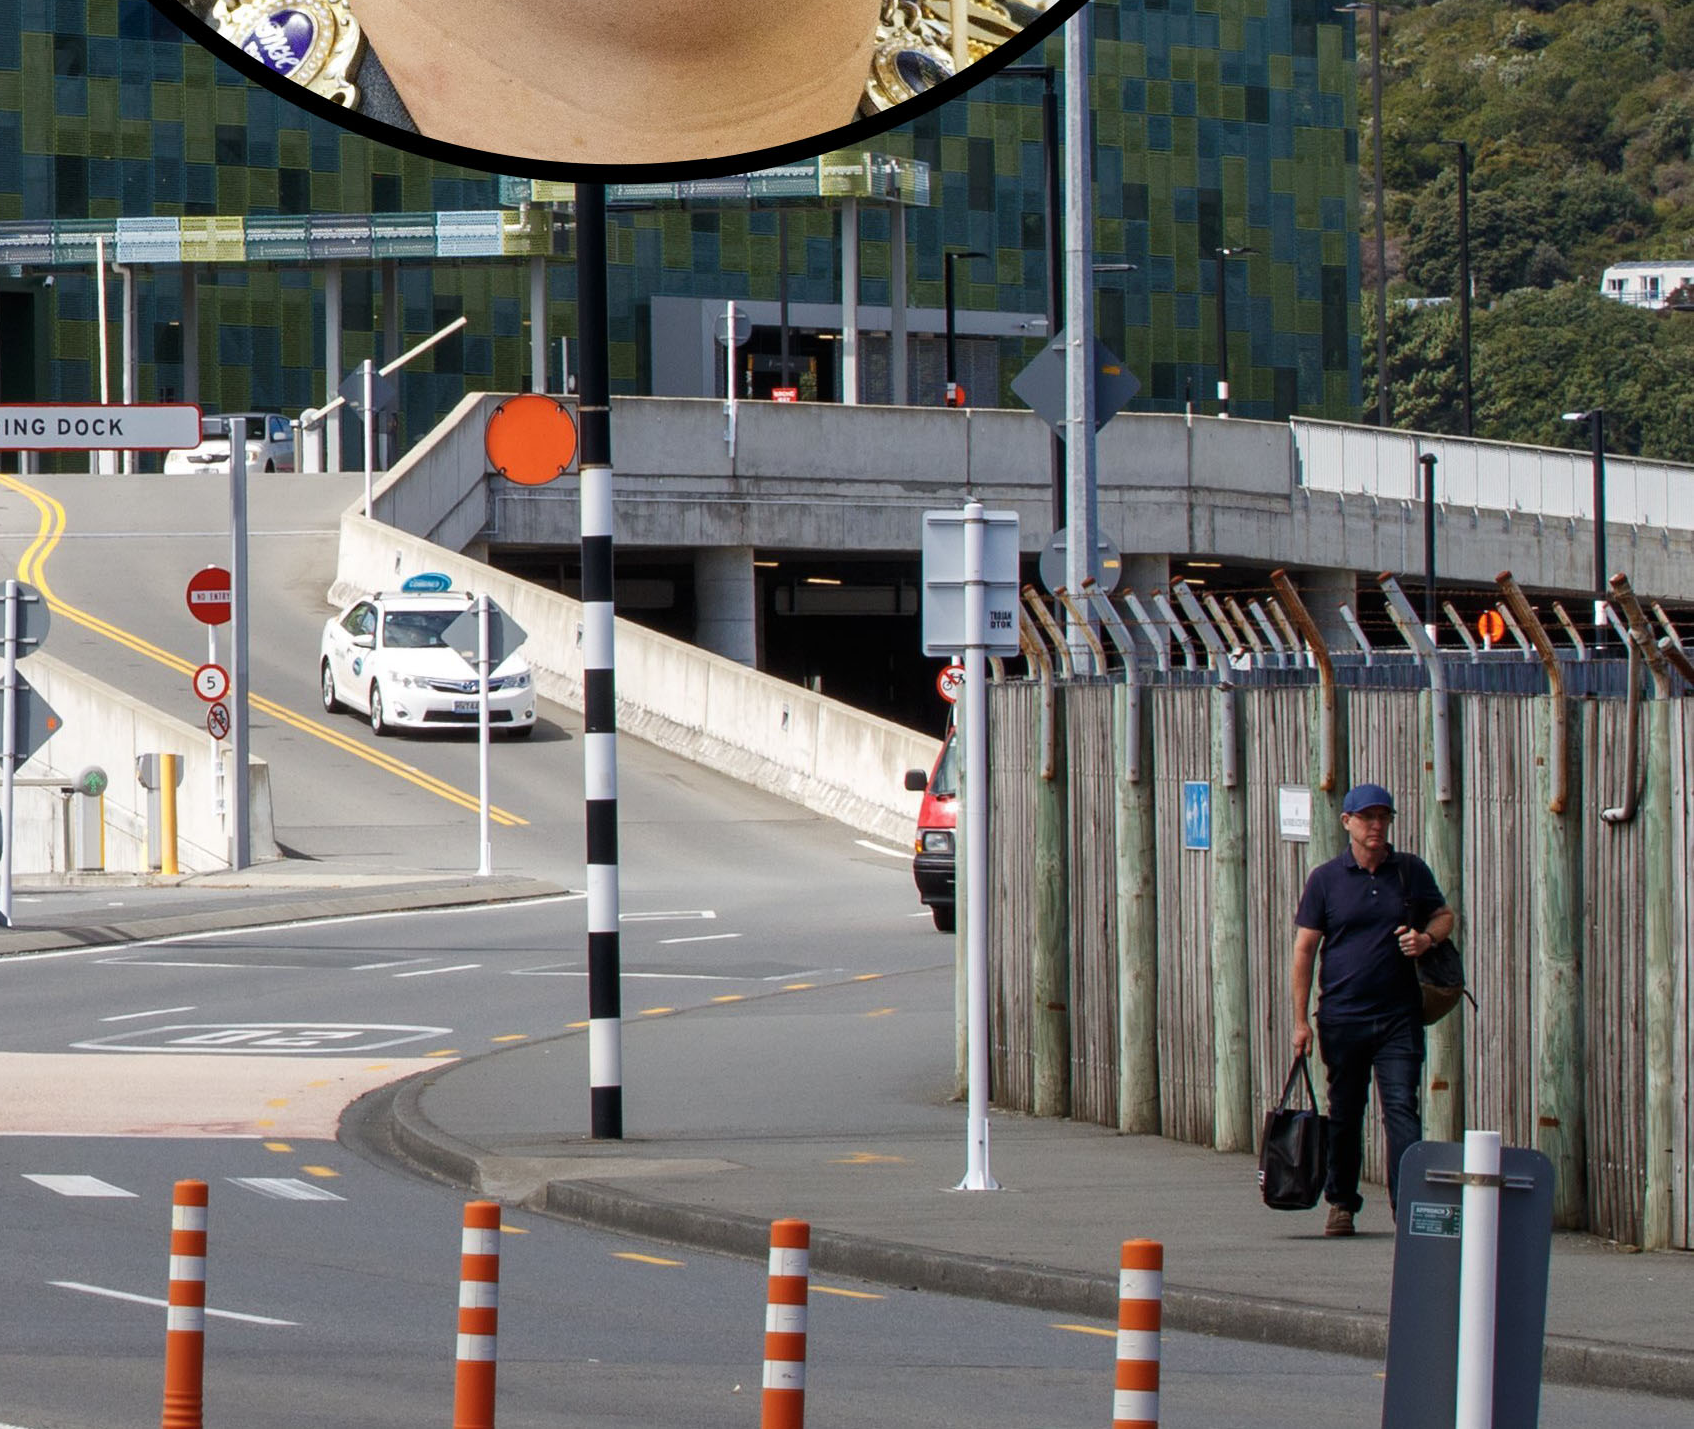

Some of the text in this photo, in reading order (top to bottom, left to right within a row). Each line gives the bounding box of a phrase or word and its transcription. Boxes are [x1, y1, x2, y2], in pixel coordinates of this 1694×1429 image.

[57, 417, 124, 437] DOCK
[196, 592, 230, 601] NO ENTRY
[206, 676, 216, 690] 5
